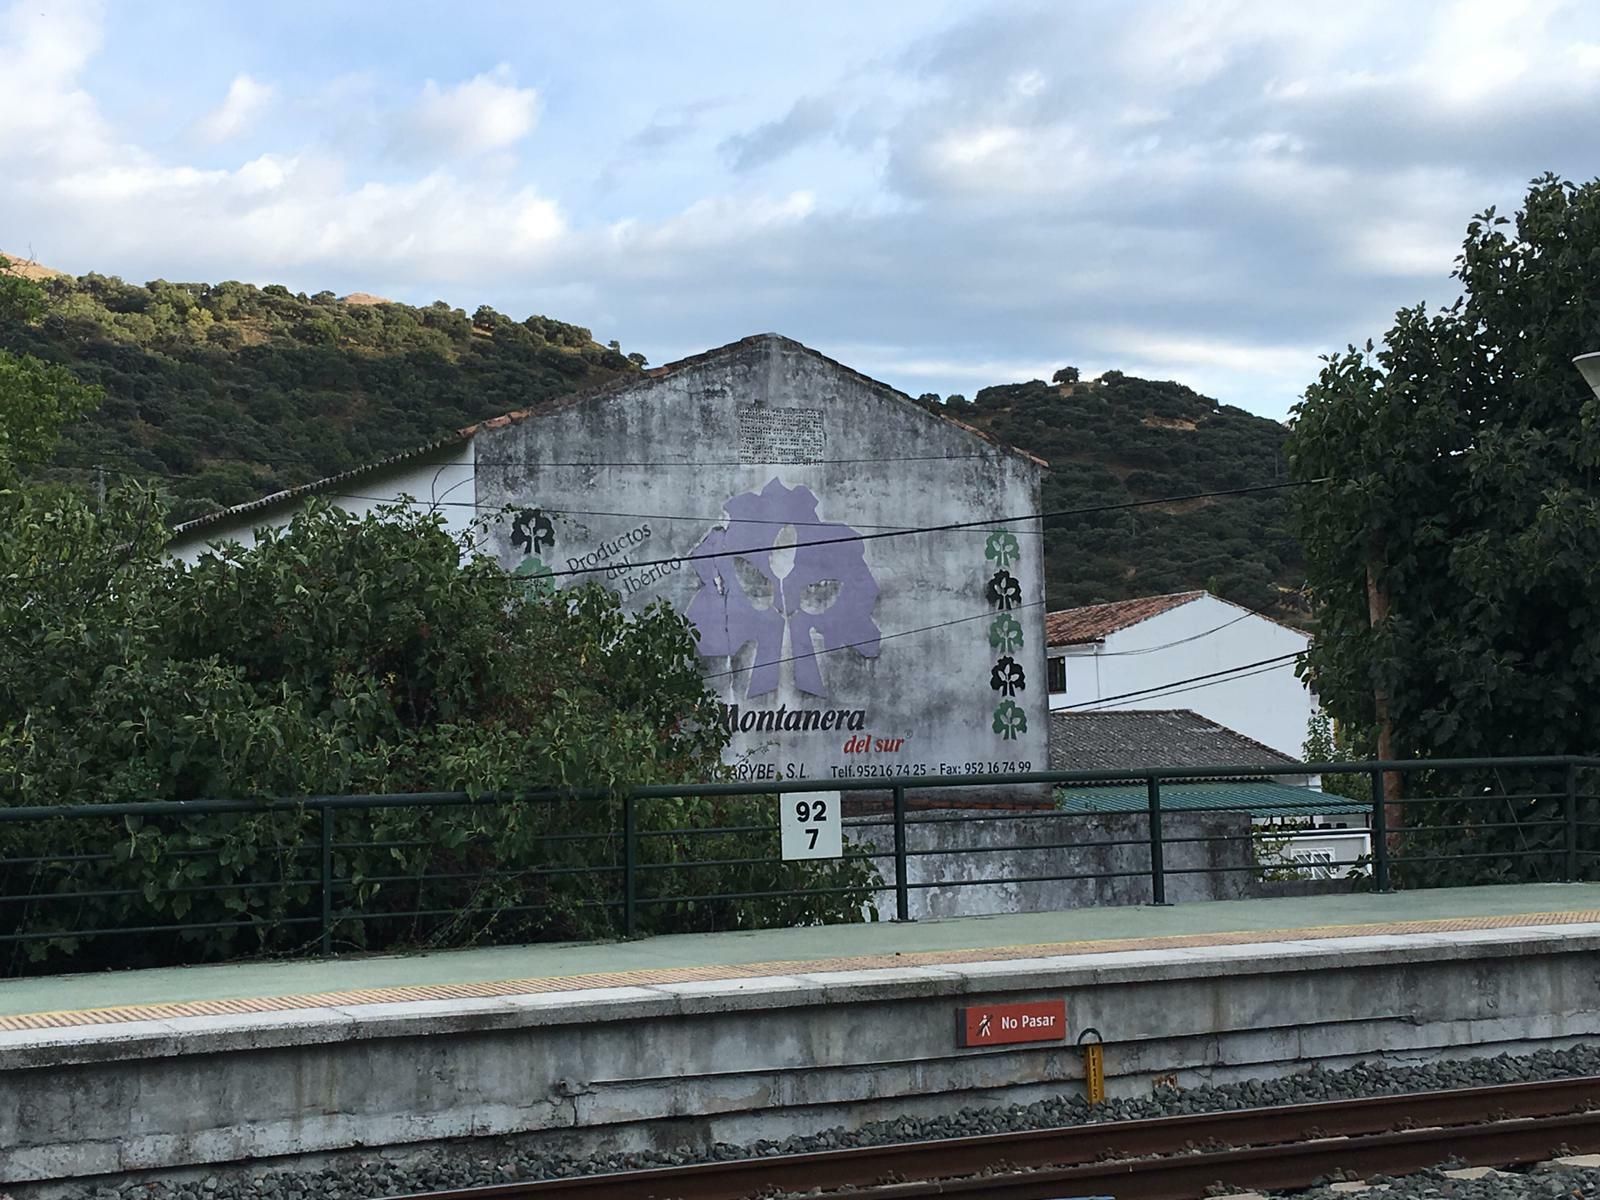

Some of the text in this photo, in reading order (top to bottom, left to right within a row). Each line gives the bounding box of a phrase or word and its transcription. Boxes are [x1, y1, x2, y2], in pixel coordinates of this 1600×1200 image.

[566, 523, 652, 575] Productos
[606, 555, 633, 580] del
[622, 557, 682, 595] Ibérico
[719, 703, 866, 733] Montanera
[843, 735, 905, 754] del sur
[786, 762, 811, 779] S.L.
[940, 762, 961, 775] Fax:
[796, 801, 827, 822] 92
[805, 829, 819, 849] 7
[1002, 1015, 1056, 1030] No Pasar
